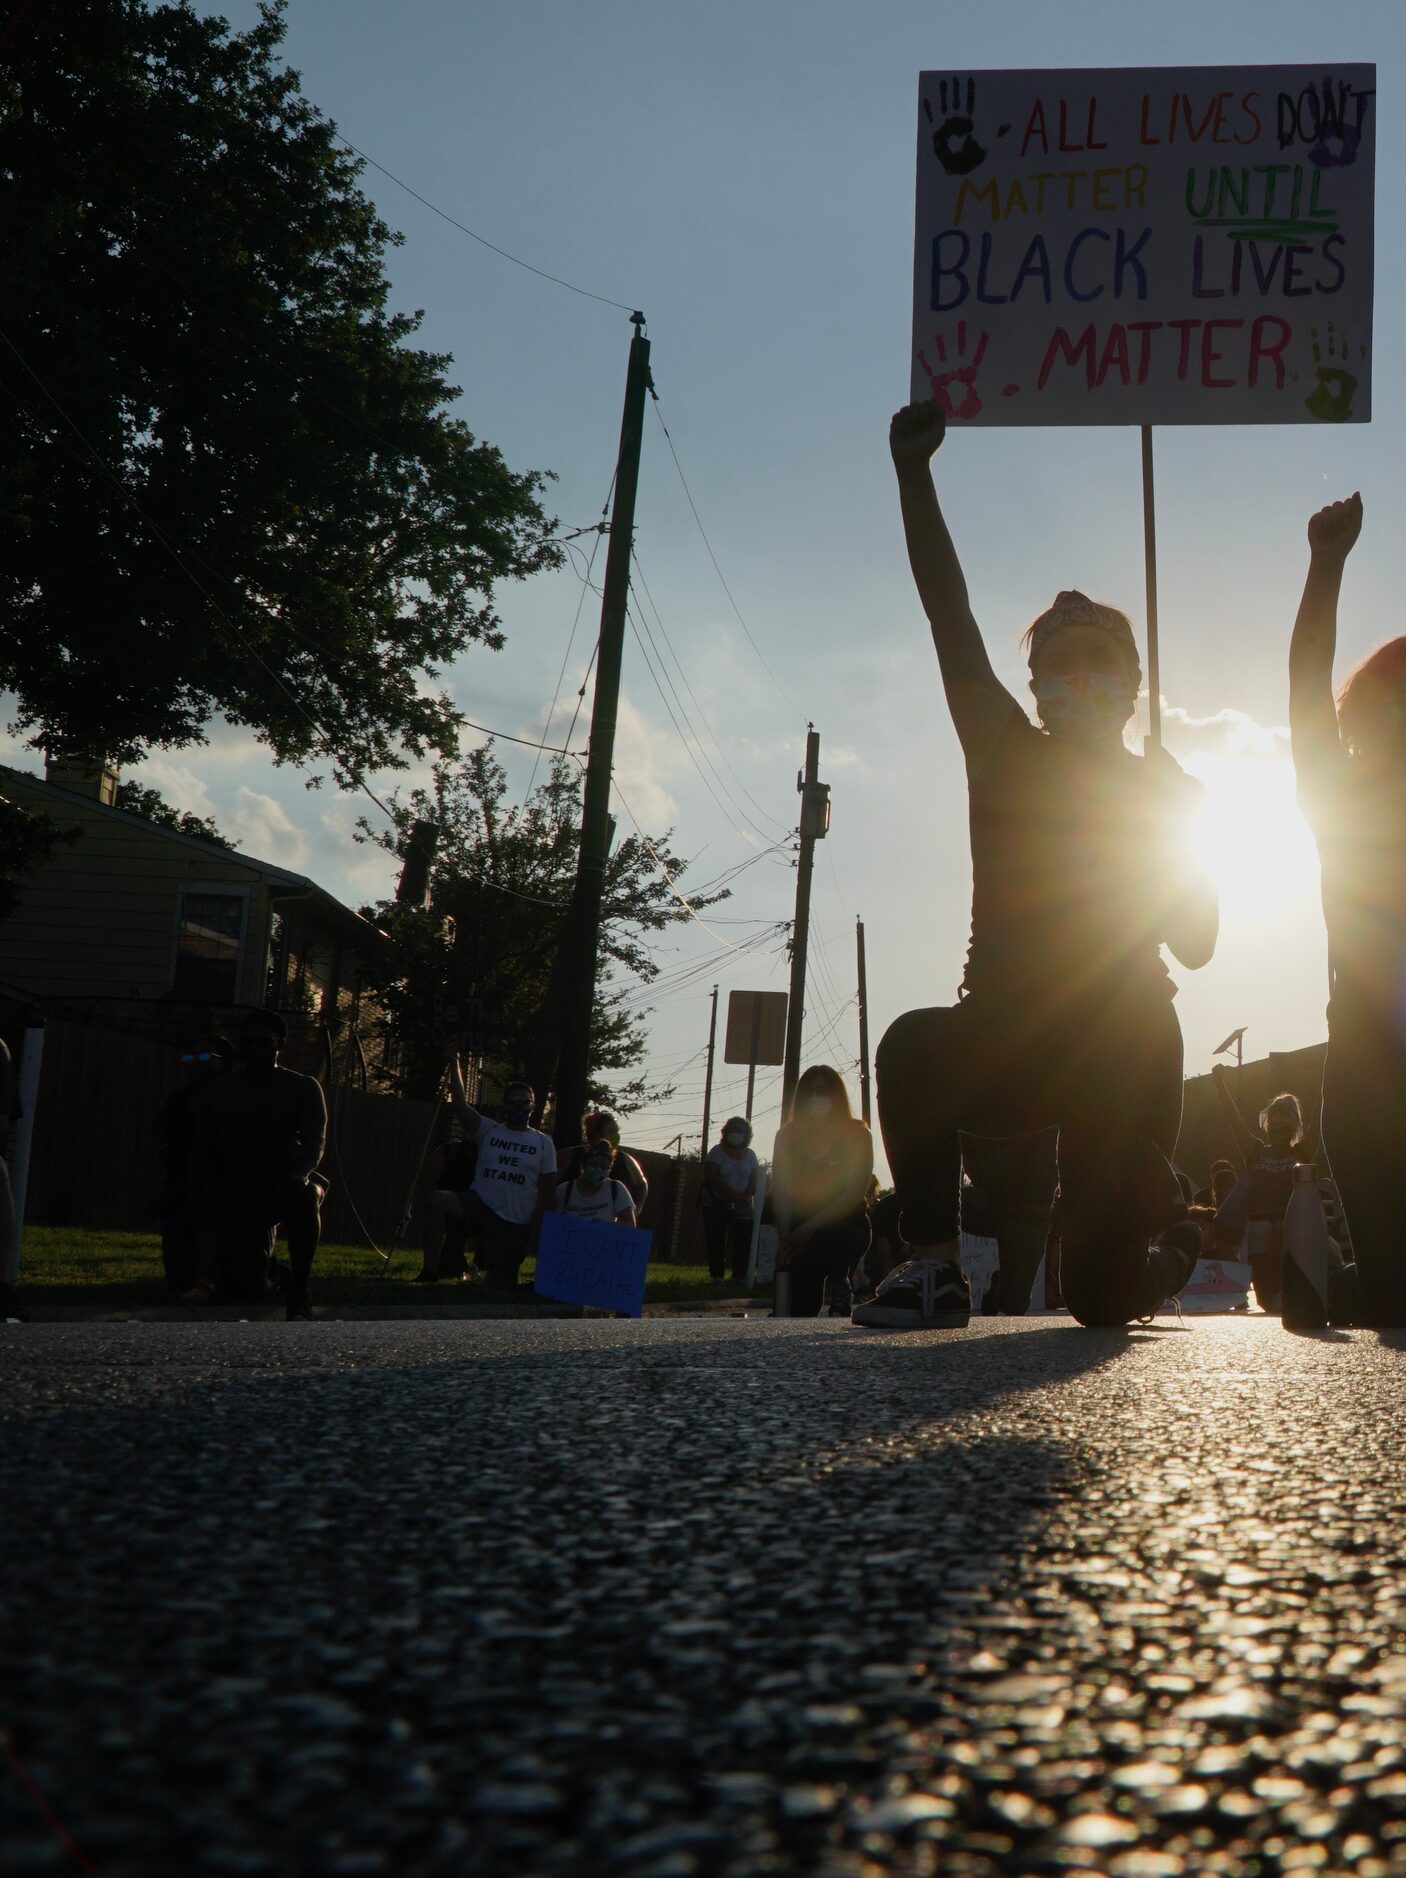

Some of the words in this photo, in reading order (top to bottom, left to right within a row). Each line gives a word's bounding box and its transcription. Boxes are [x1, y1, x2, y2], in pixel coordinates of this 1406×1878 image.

[1021, 96, 1108, 157] ALL
[1140, 92, 1262, 145] LIVES
[954, 163, 1149, 225] MATTER
[1186, 164, 1338, 219] UNTIL
[930, 227, 1152, 311] BLACK
[1193, 234, 1346, 298] LIVES
[1038, 314, 1292, 391] MATTER
[489, 1137, 537, 1155] UNITED
[499, 1154, 519, 1167] WE
[483, 1167, 526, 1185] STAND
[559, 1228, 581, 1255] I
